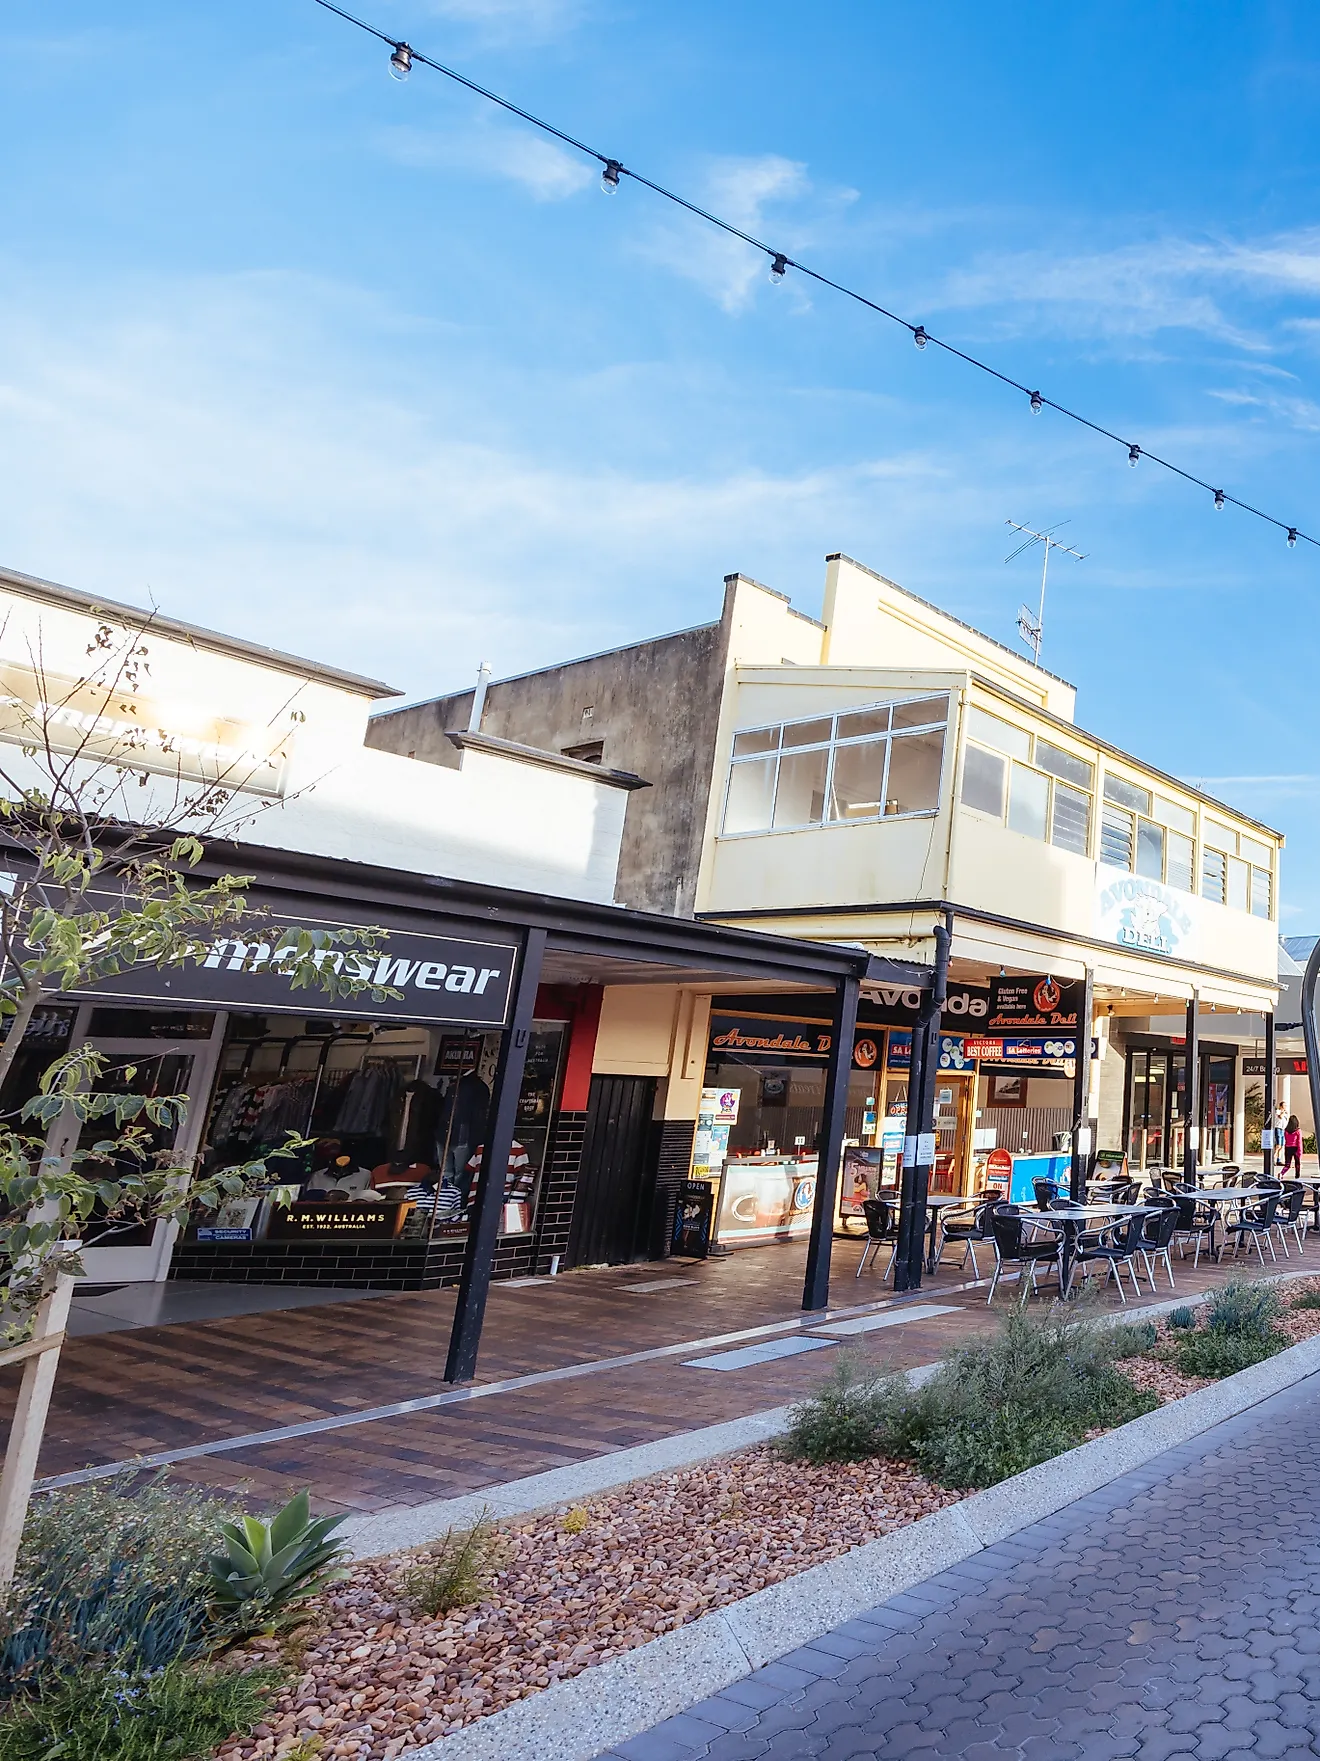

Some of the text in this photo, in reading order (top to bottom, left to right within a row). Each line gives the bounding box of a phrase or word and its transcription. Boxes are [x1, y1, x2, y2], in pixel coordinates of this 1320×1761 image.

[998, 987, 1028, 995] Gluten Free
[1002, 995, 1019, 1003] Vegan
[988, 1012, 1077, 1025] Avondale Deli
[713, 1028, 811, 1051] Avondale
[966, 1046, 1002, 1057] BEST COFFEE
[1016, 1047, 1041, 1055] Lotteries
[686, 1182, 705, 1191] OPEN
